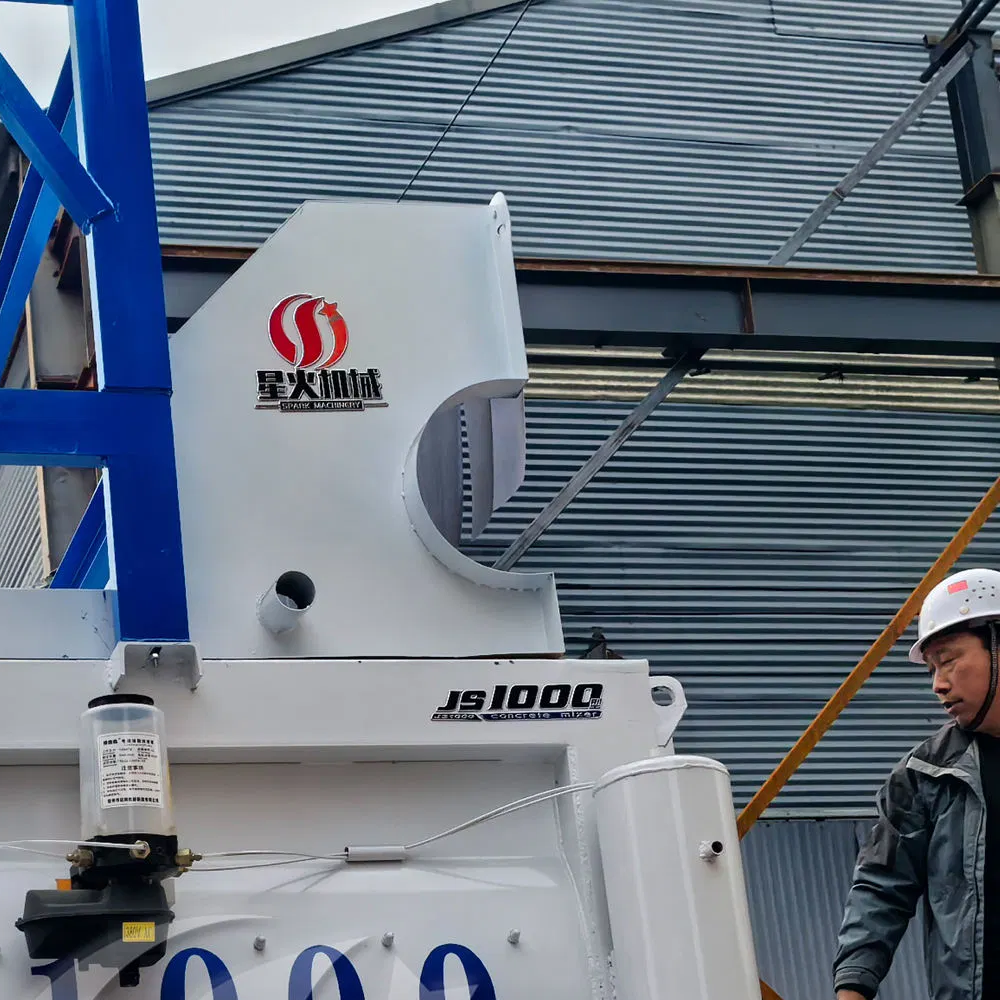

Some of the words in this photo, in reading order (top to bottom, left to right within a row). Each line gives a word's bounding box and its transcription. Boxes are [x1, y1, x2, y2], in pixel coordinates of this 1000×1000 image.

[256, 368, 382, 400] 星火机械
[281, 402, 311, 410] SPARK
[313, 401, 362, 409] MACHINERY
[436, 683, 604, 711] JS1000
